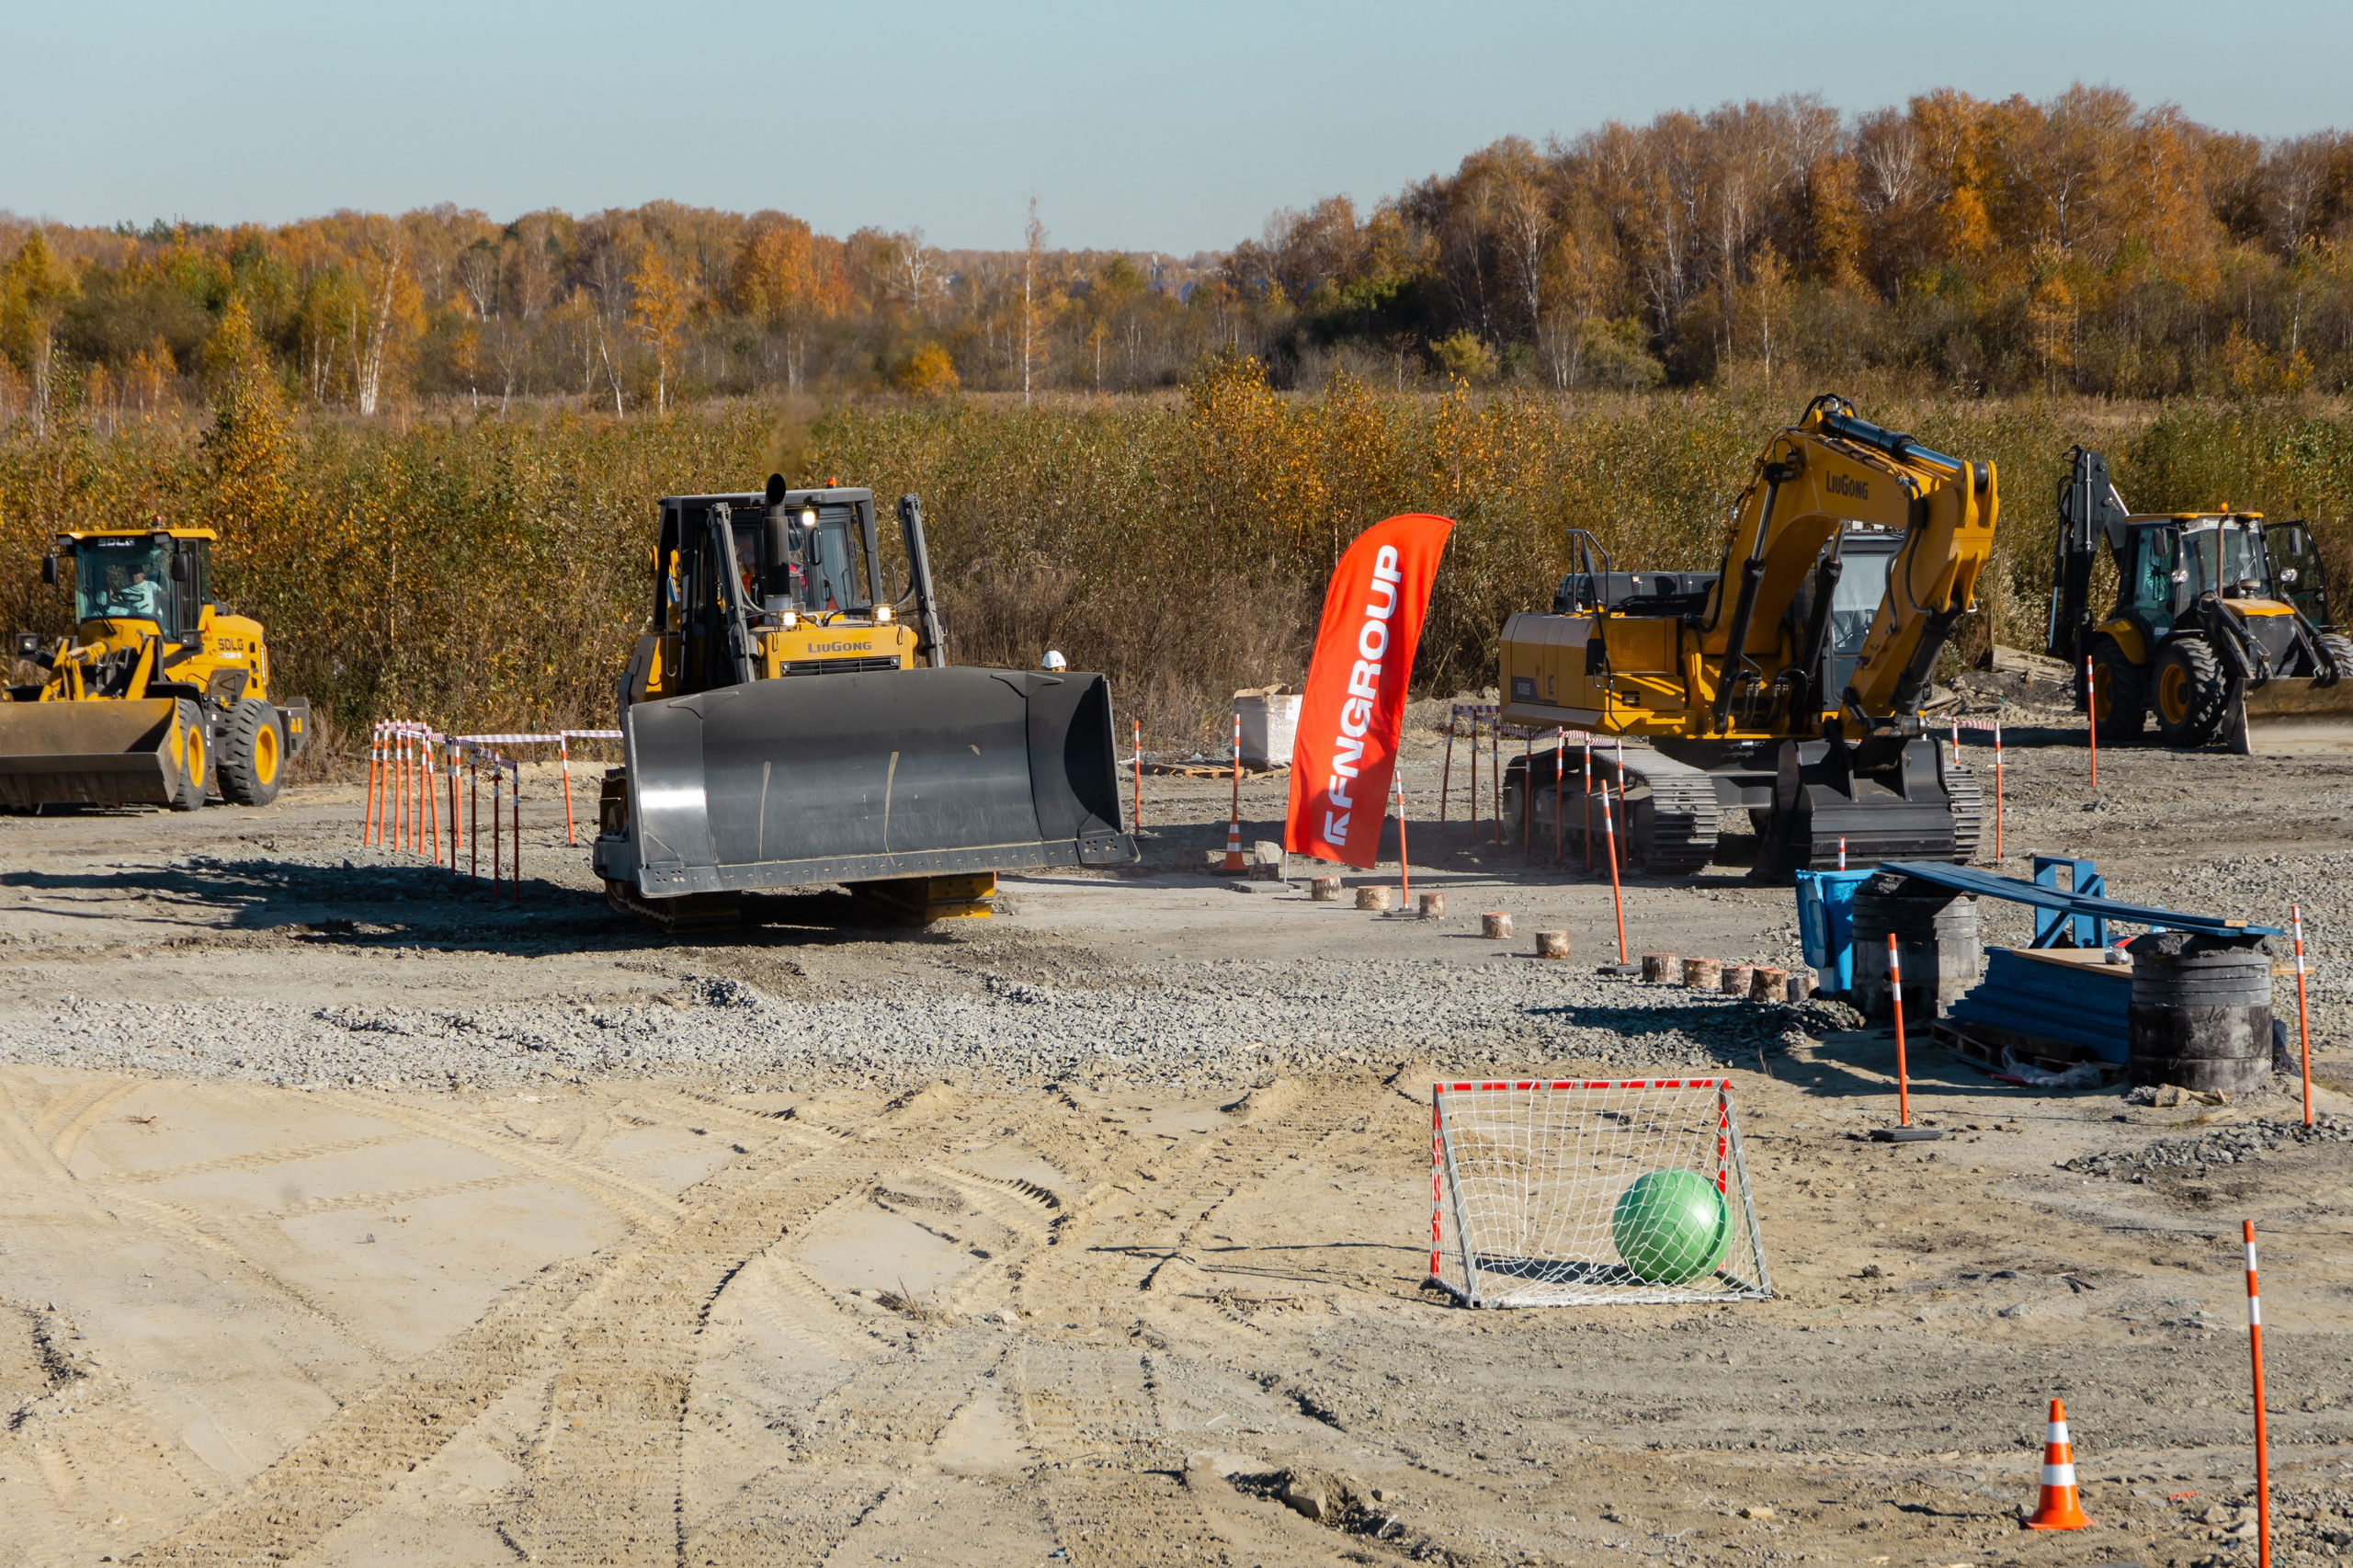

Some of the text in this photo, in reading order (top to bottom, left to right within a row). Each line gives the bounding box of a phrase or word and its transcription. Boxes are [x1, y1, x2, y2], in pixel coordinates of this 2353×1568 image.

[98, 538, 135, 546] SDLG
[218, 639, 244, 651] SDLG
[1329, 545, 1402, 809] FNGROUP
